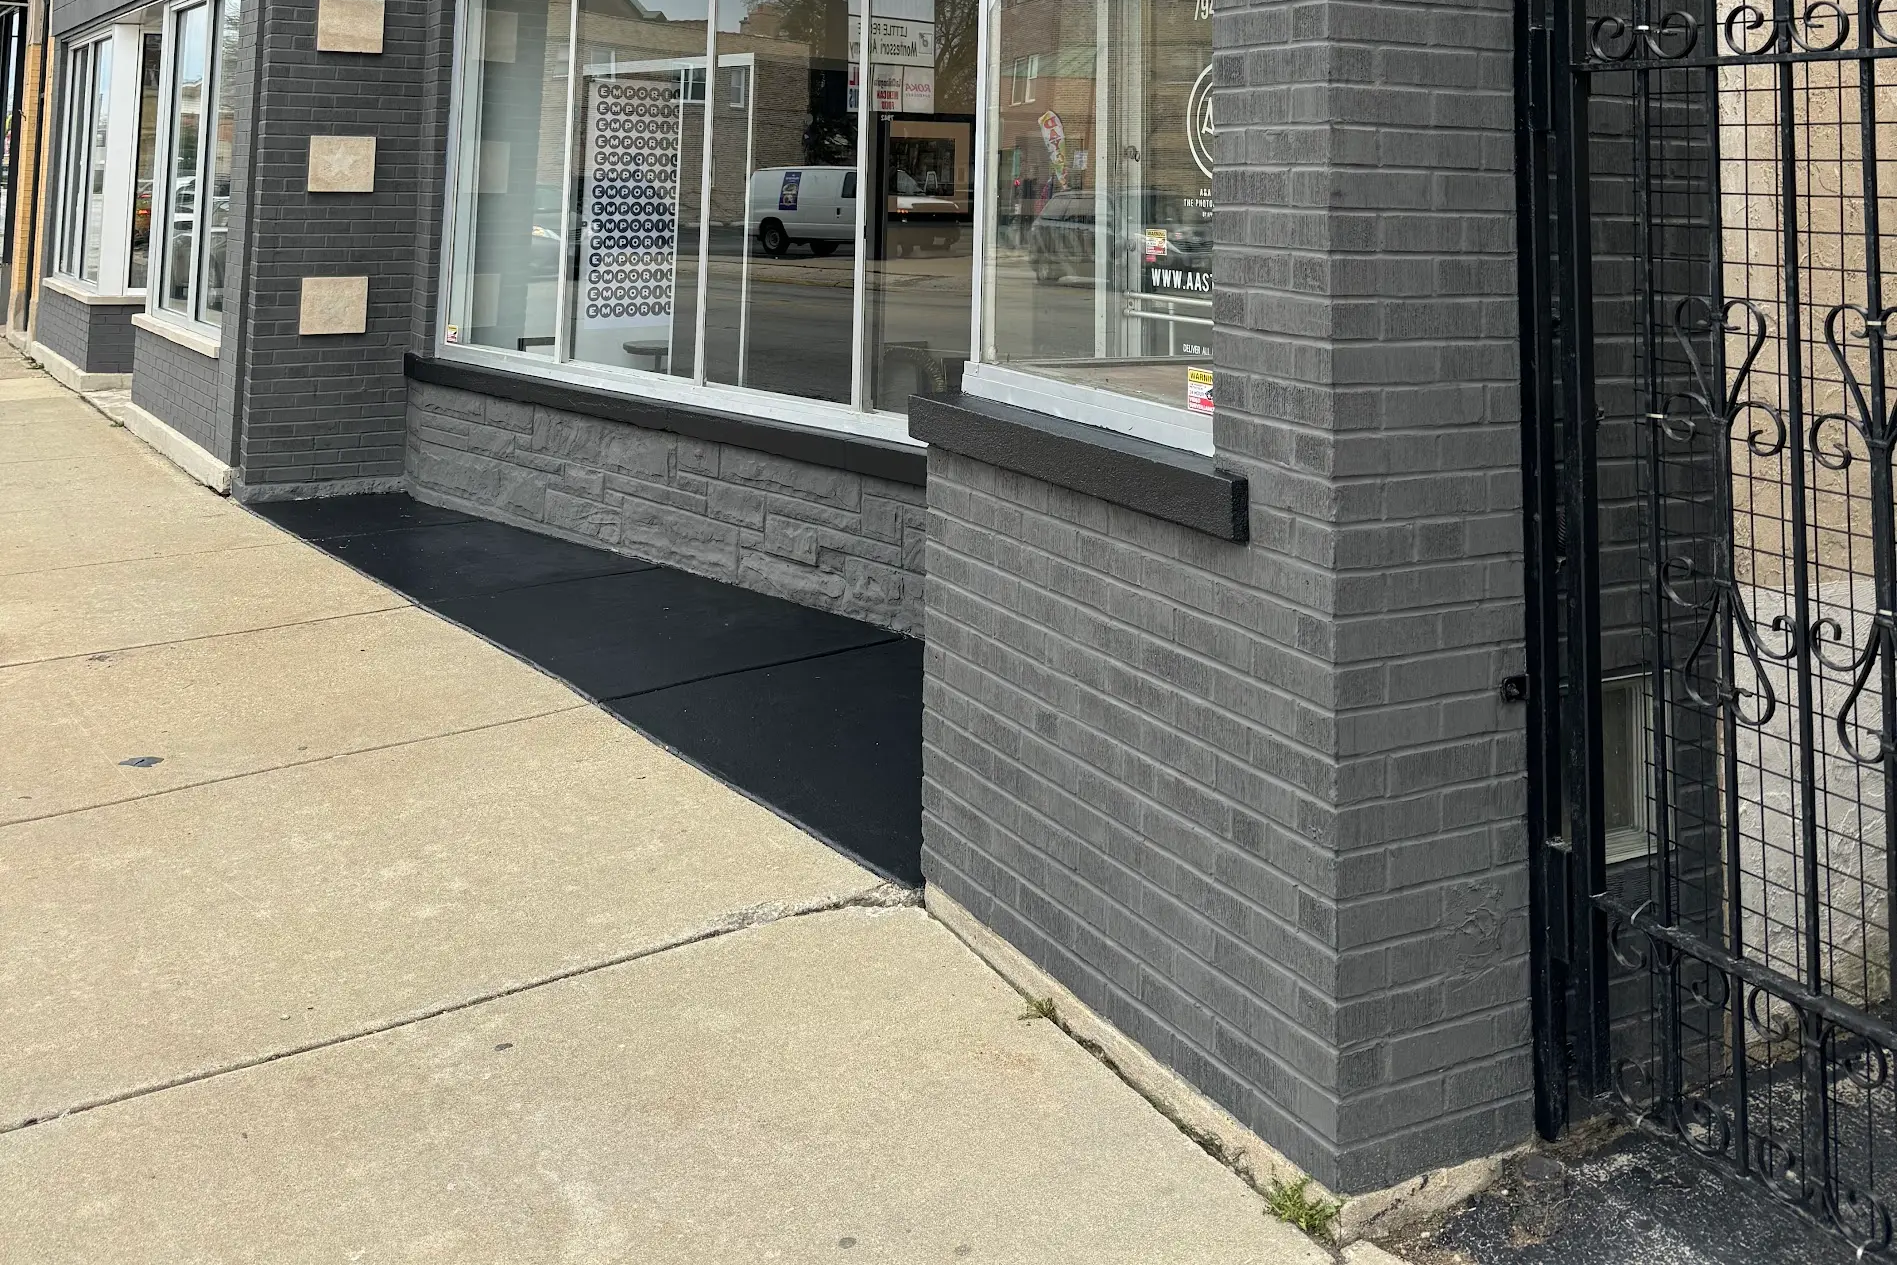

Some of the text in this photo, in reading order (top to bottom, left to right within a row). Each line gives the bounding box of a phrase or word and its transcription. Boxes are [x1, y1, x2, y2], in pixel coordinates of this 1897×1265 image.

[1183, 198, 1215, 207] THE PHOTO
[1182, 343, 1200, 355] DELIVER
